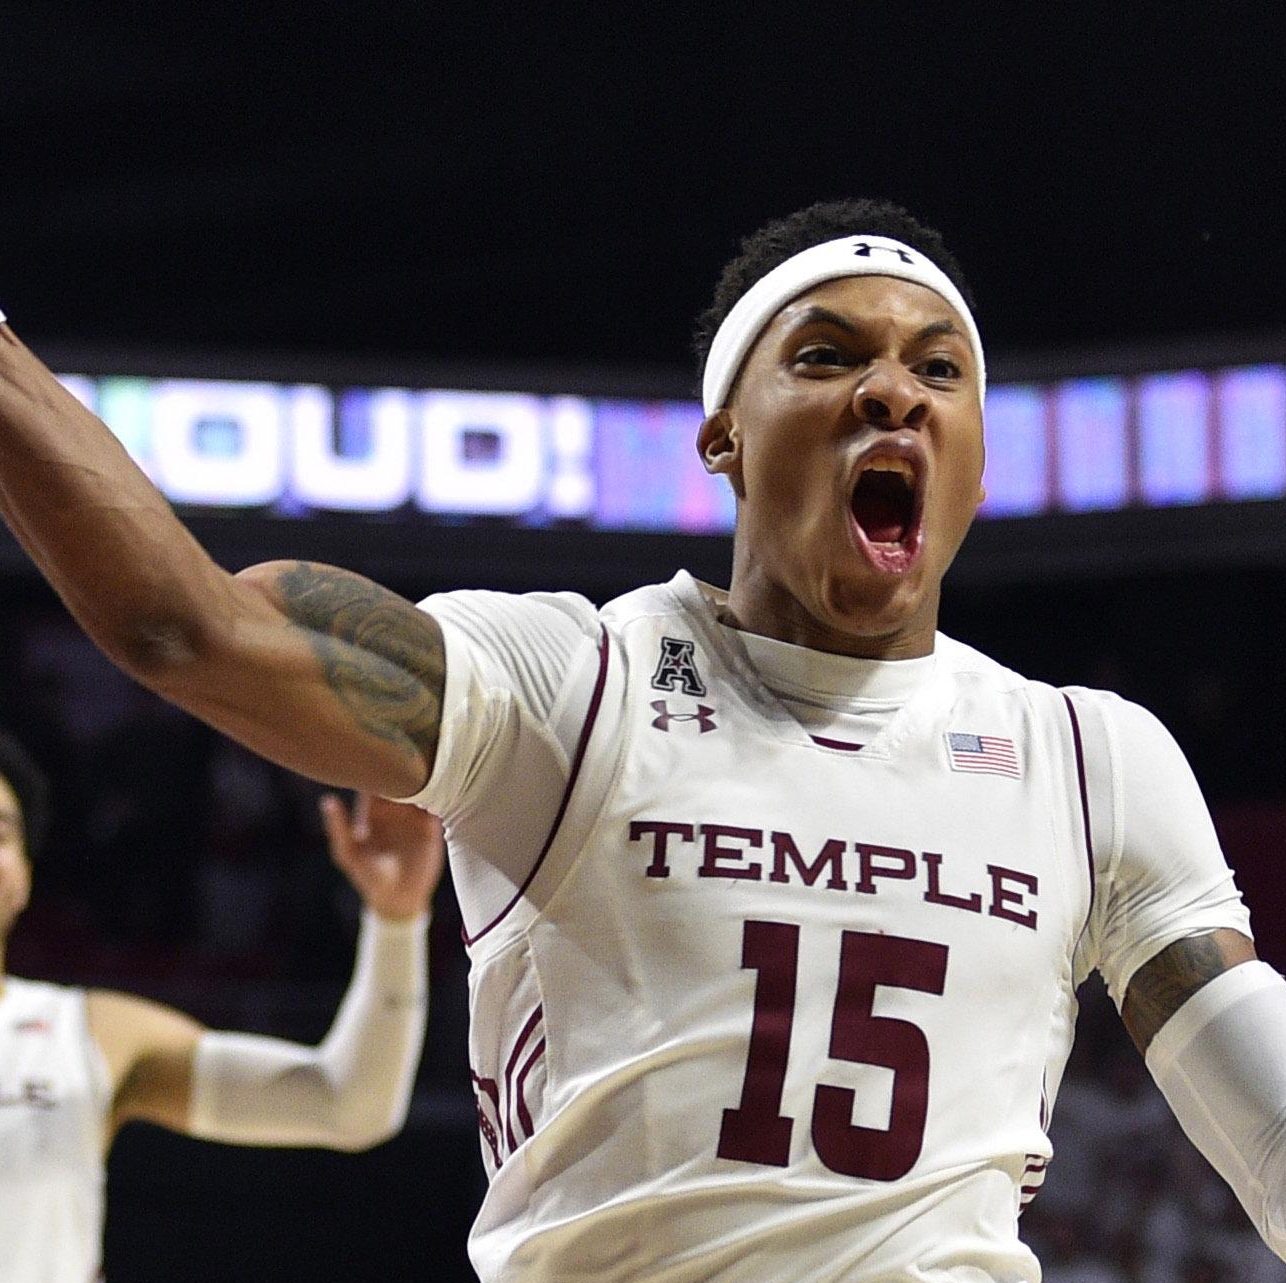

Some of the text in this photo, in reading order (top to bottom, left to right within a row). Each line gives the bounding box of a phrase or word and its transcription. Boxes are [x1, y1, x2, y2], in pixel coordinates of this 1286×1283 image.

[55, 374, 593, 518] OUD!
[650, 636, 707, 698] A
[628, 819, 1039, 931] TEMPLE
[715, 919, 950, 1182] 15
